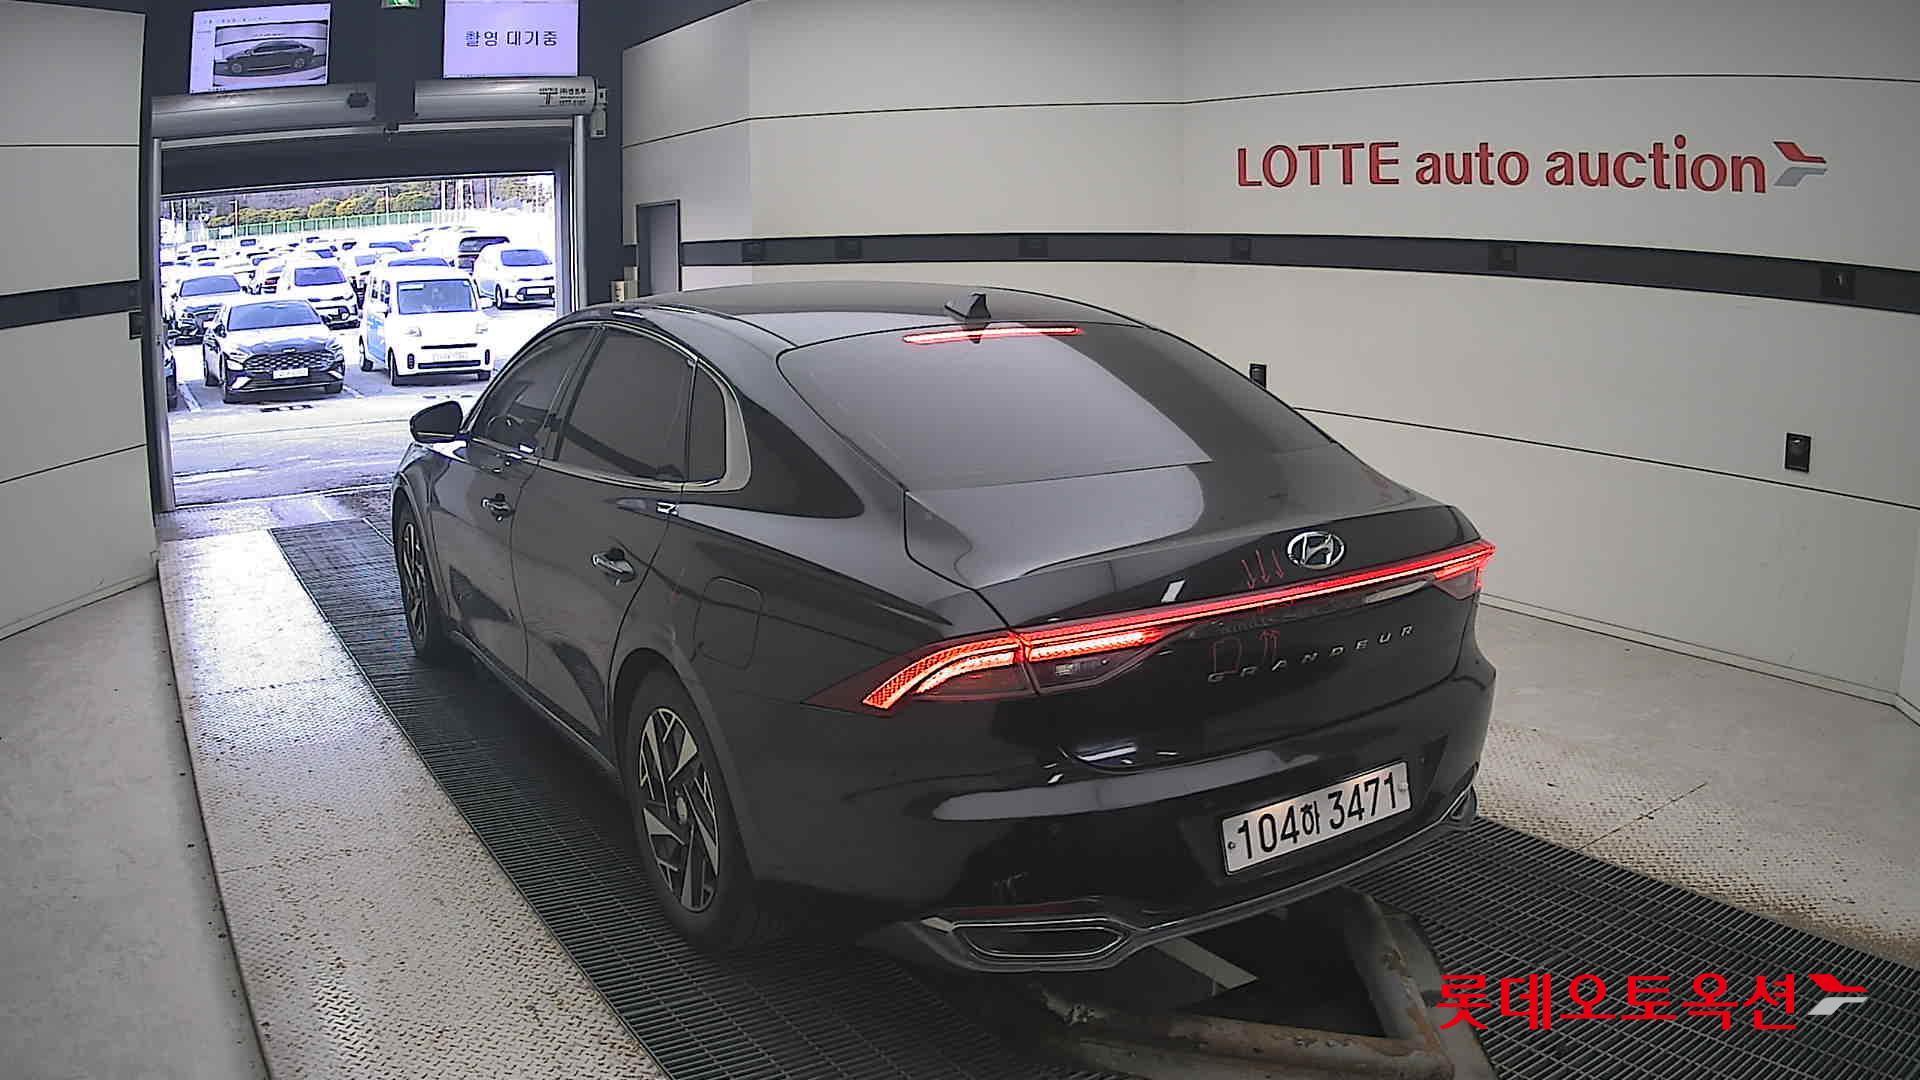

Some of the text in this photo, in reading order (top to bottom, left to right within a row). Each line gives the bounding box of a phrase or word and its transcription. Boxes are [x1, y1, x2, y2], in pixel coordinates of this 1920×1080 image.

[506, 30, 558, 47] 대기중
[1237, 134, 1767, 194] LOTTE auto auction
[1207, 623, 1414, 683] GRANDEUR
[1237, 771, 1397, 860] 104하 3471
